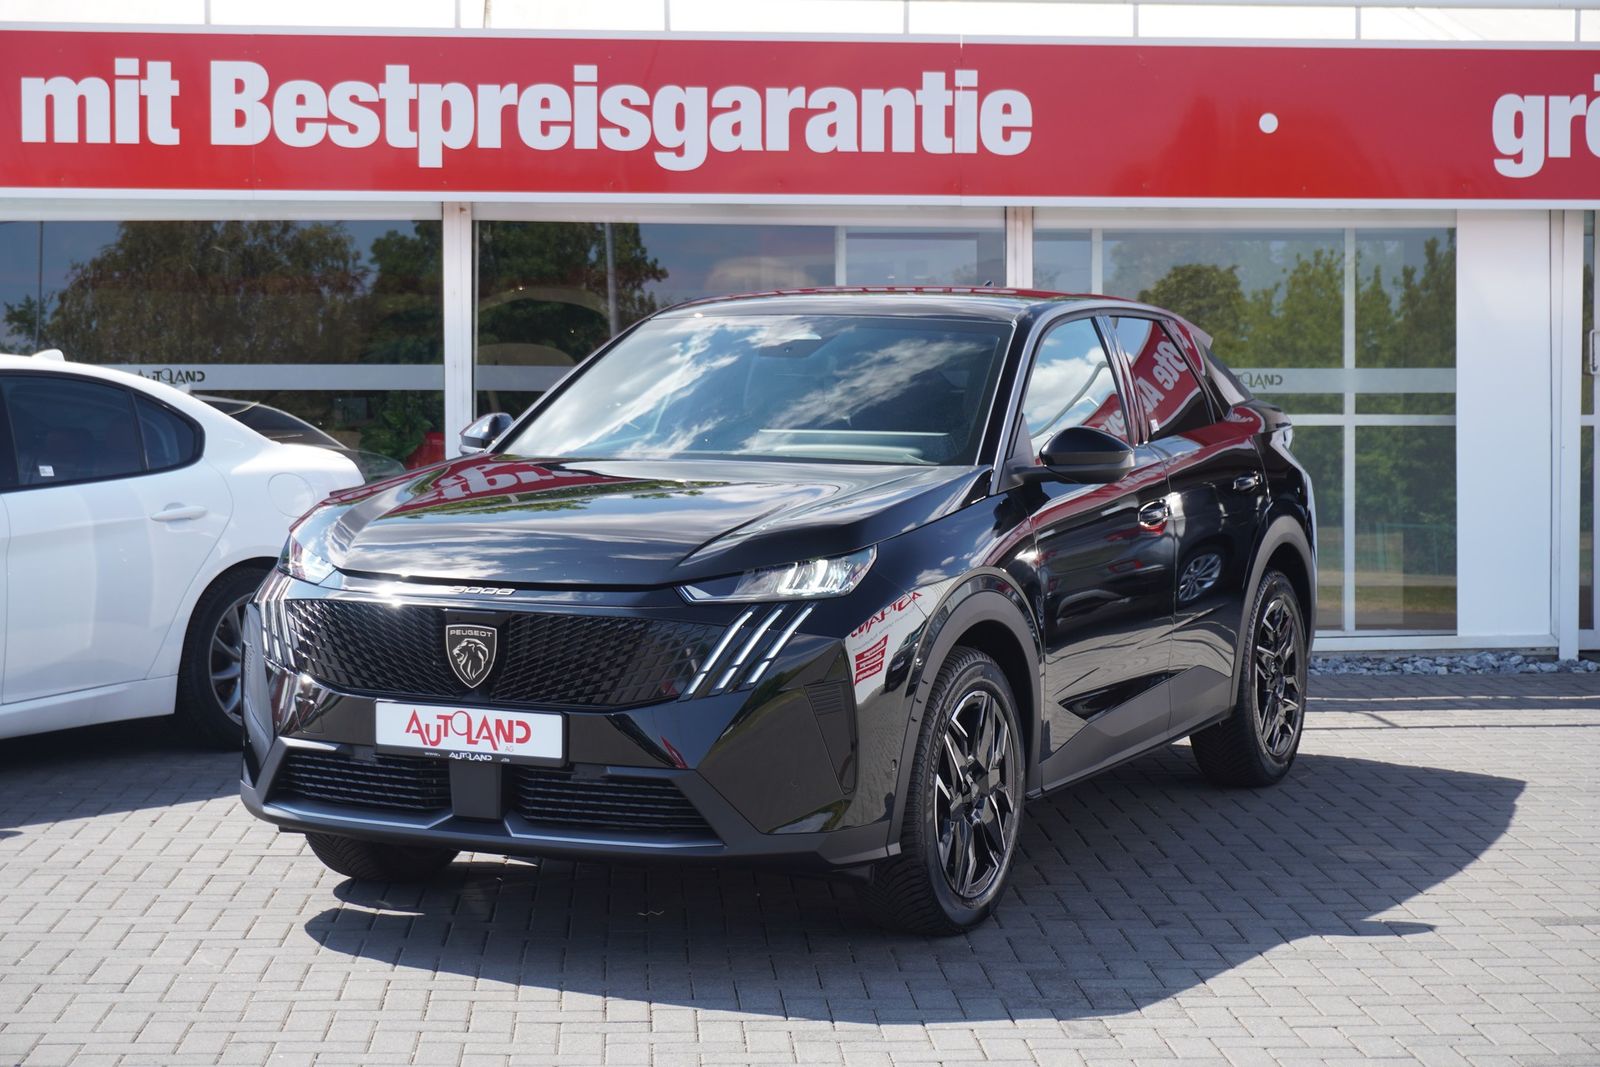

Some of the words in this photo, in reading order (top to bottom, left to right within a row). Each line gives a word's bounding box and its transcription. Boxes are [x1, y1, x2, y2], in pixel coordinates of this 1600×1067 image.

[21, 57, 181, 146] mit
[210, 60, 1033, 172] Bestpreisgarantie
[1492, 73, 1600, 178] gr
[449, 629, 493, 638] PEUGEOT
